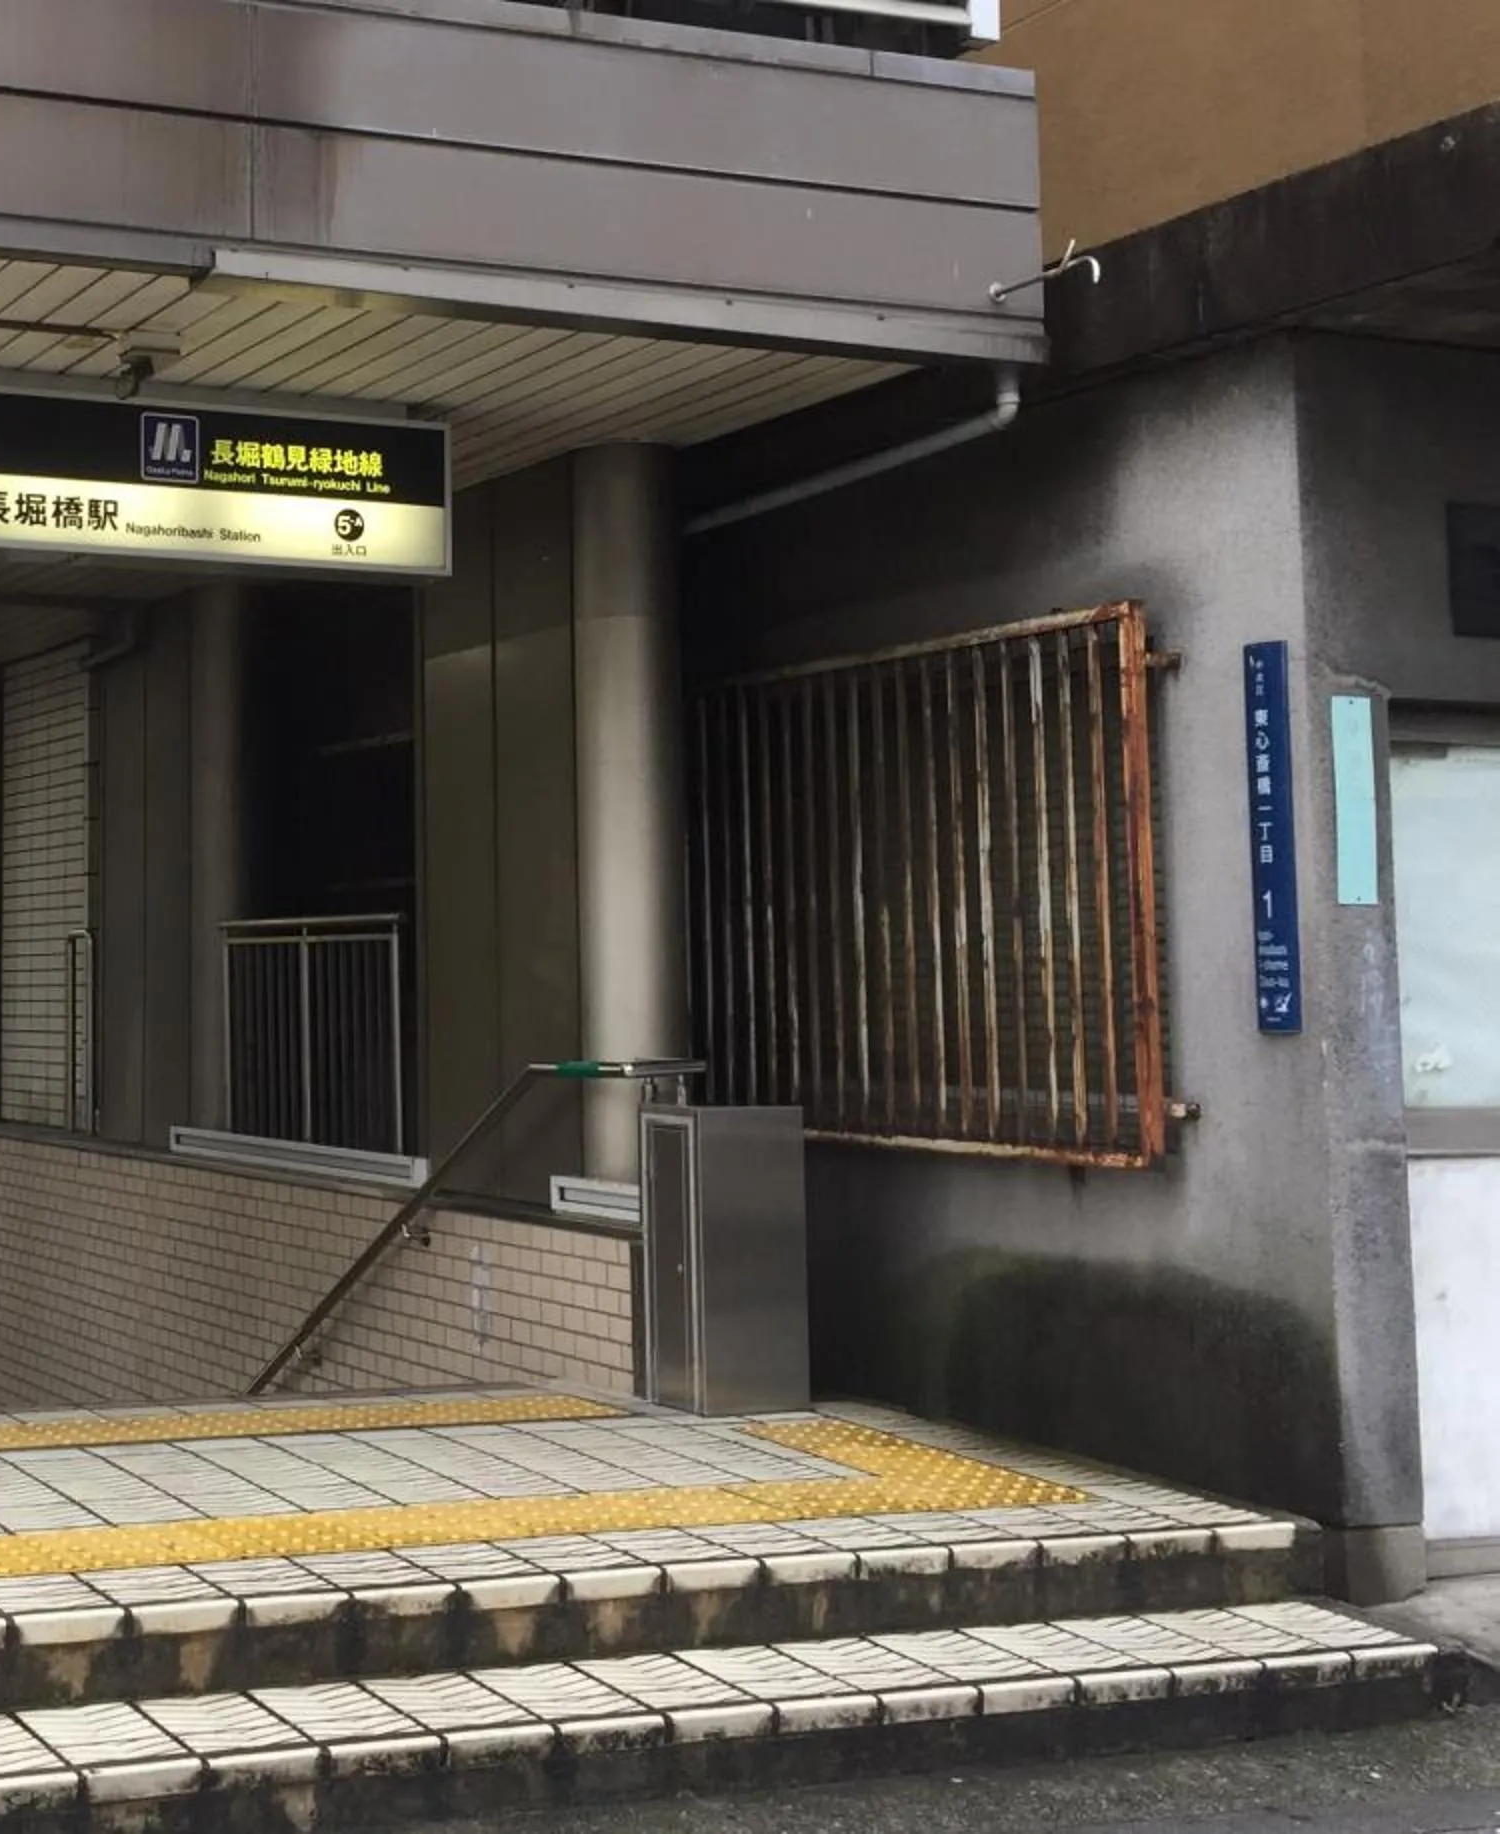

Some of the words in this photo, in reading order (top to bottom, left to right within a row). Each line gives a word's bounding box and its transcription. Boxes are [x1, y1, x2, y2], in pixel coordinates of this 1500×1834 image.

[210, 439, 383, 477] 長堀鶴見緑地線
[204, 469, 256, 486] Nagahori
[261, 473, 361, 492] Tsurumi-ryokuchi
[366, 481, 391, 494] Line
[125, 522, 213, 539] Nagahoribashi
[219, 527, 261, 542] Station
[331, 544, 367, 557] 出入口
[1262, 889, 1273, 919] 1
